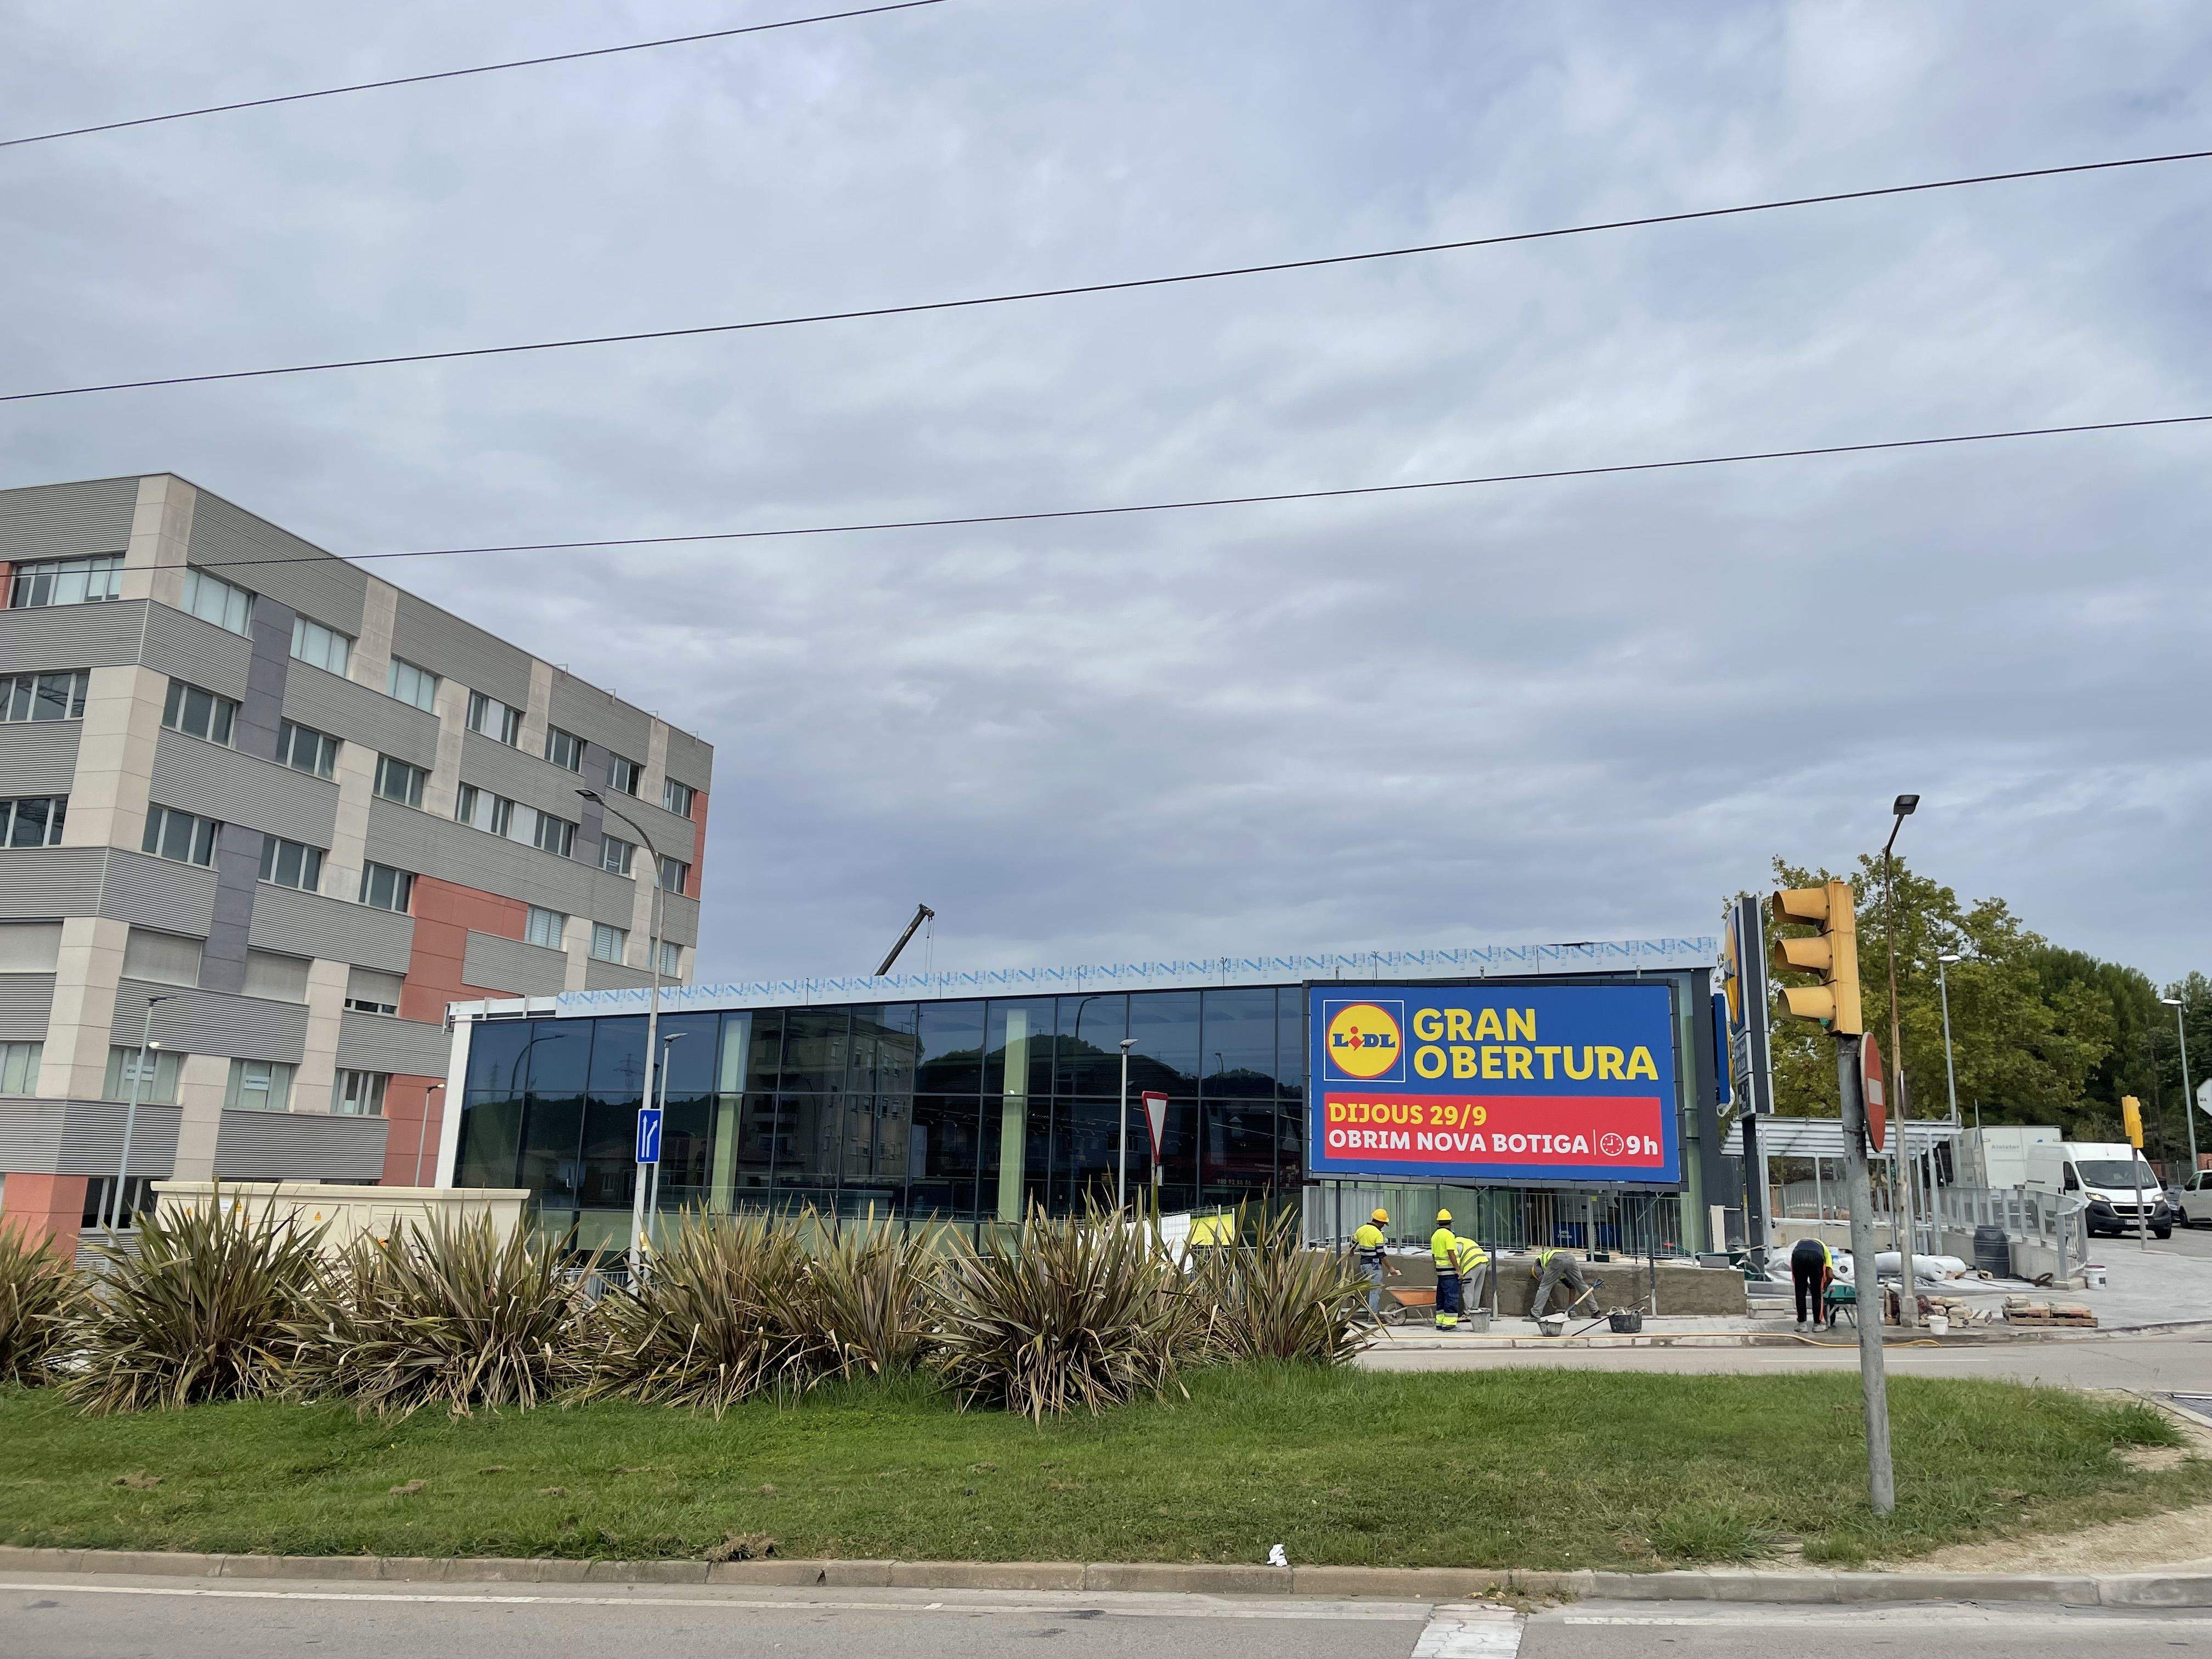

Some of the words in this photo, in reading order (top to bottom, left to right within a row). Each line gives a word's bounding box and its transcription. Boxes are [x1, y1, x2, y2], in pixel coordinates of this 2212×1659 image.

[1414, 1009, 1535, 1041] GRAN
[1415, 1046, 1657, 1080] OBERTURA
[1329, 1103, 1423, 1124] DIJOUS
[1431, 1104, 1486, 1128] 29/9
[1329, 1130, 1409, 1149] OBRIM
[1418, 1132, 1486, 1151] NOVA
[1492, 1134, 1588, 1153] BOTIGA
